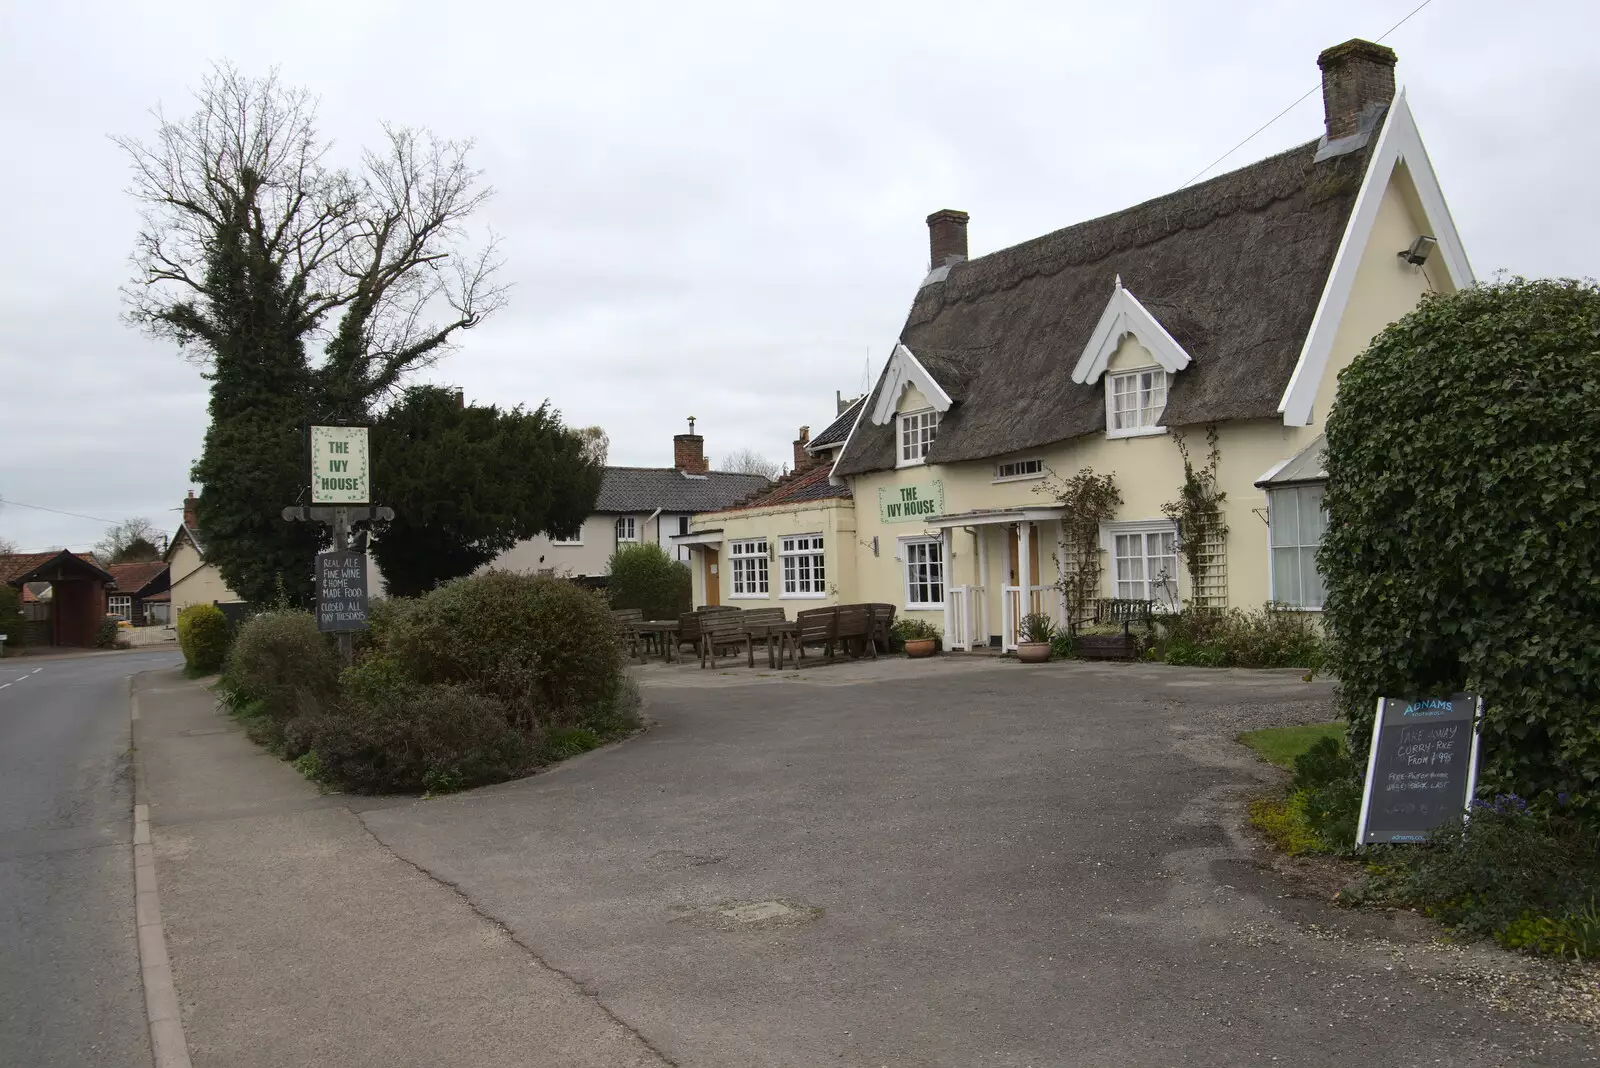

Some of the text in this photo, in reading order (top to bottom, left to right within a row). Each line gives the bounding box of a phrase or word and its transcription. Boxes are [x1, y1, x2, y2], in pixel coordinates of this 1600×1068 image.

[328, 441, 349, 454] THE
[329, 460, 348, 472] IVY
[321, 478, 359, 490] HOUSE
[900, 487, 918, 501] THE
[887, 500, 935, 517] IVY HOUSE
[323, 559, 340, 568] REAL
[323, 569, 360, 578] FINE WINE
[328, 580, 348, 588] HOME
[322, 588, 341, 598] MADE
[321, 601, 362, 612] CLOSED ALL
[321, 611, 366, 623] DAY TUESDAYS
[1403, 700, 1453, 715] ADNAMS
[1407, 754, 1429, 766] FROM
